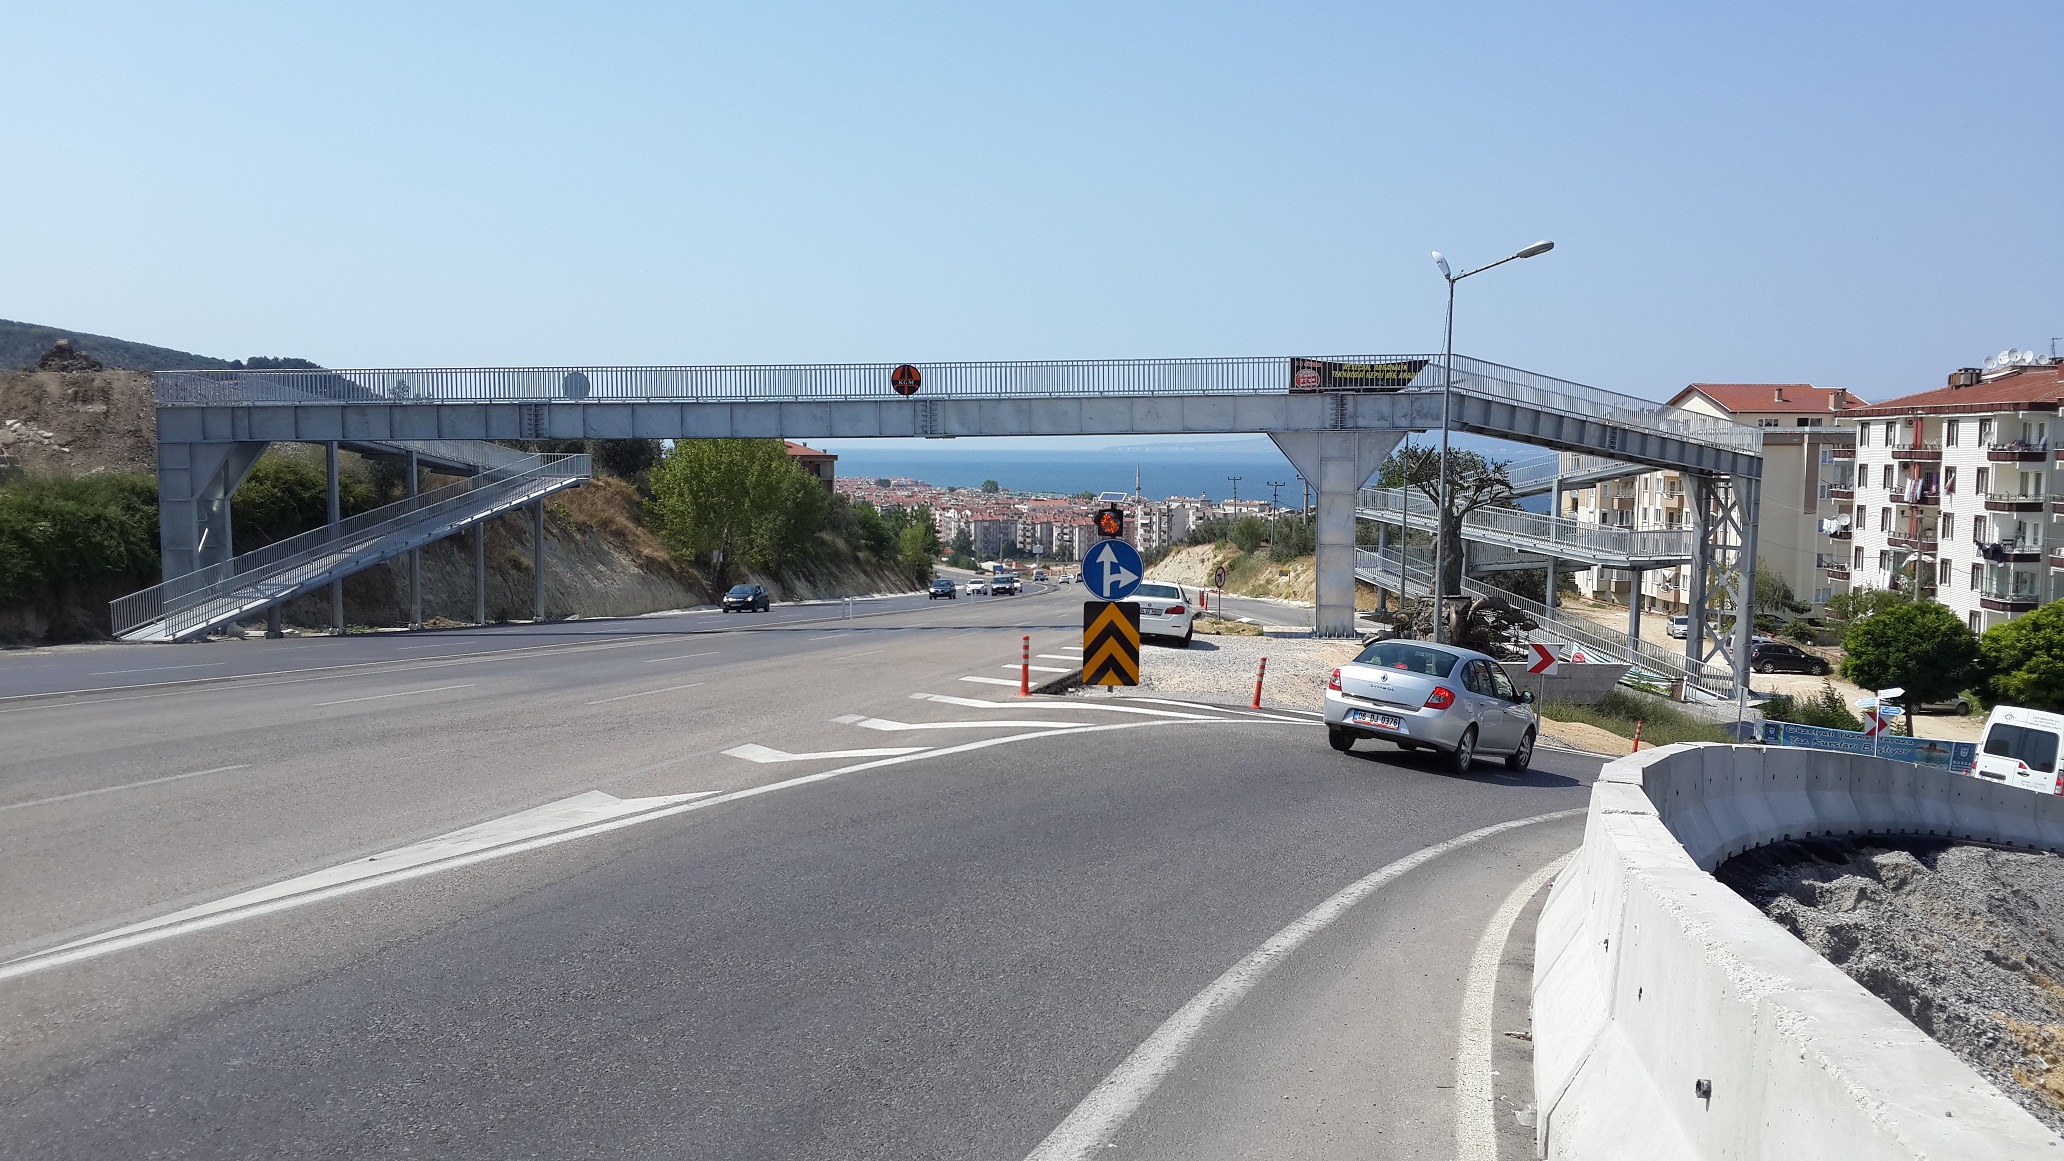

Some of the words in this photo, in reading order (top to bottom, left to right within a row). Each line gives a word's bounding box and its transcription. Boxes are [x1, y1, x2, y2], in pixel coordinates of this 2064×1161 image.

[1370, 713, 1379, 723] DJ
[1381, 716, 1398, 727] 0376
[1790, 735, 1809, 745] Yaz
[1812, 738, 1858, 750] Kursları
